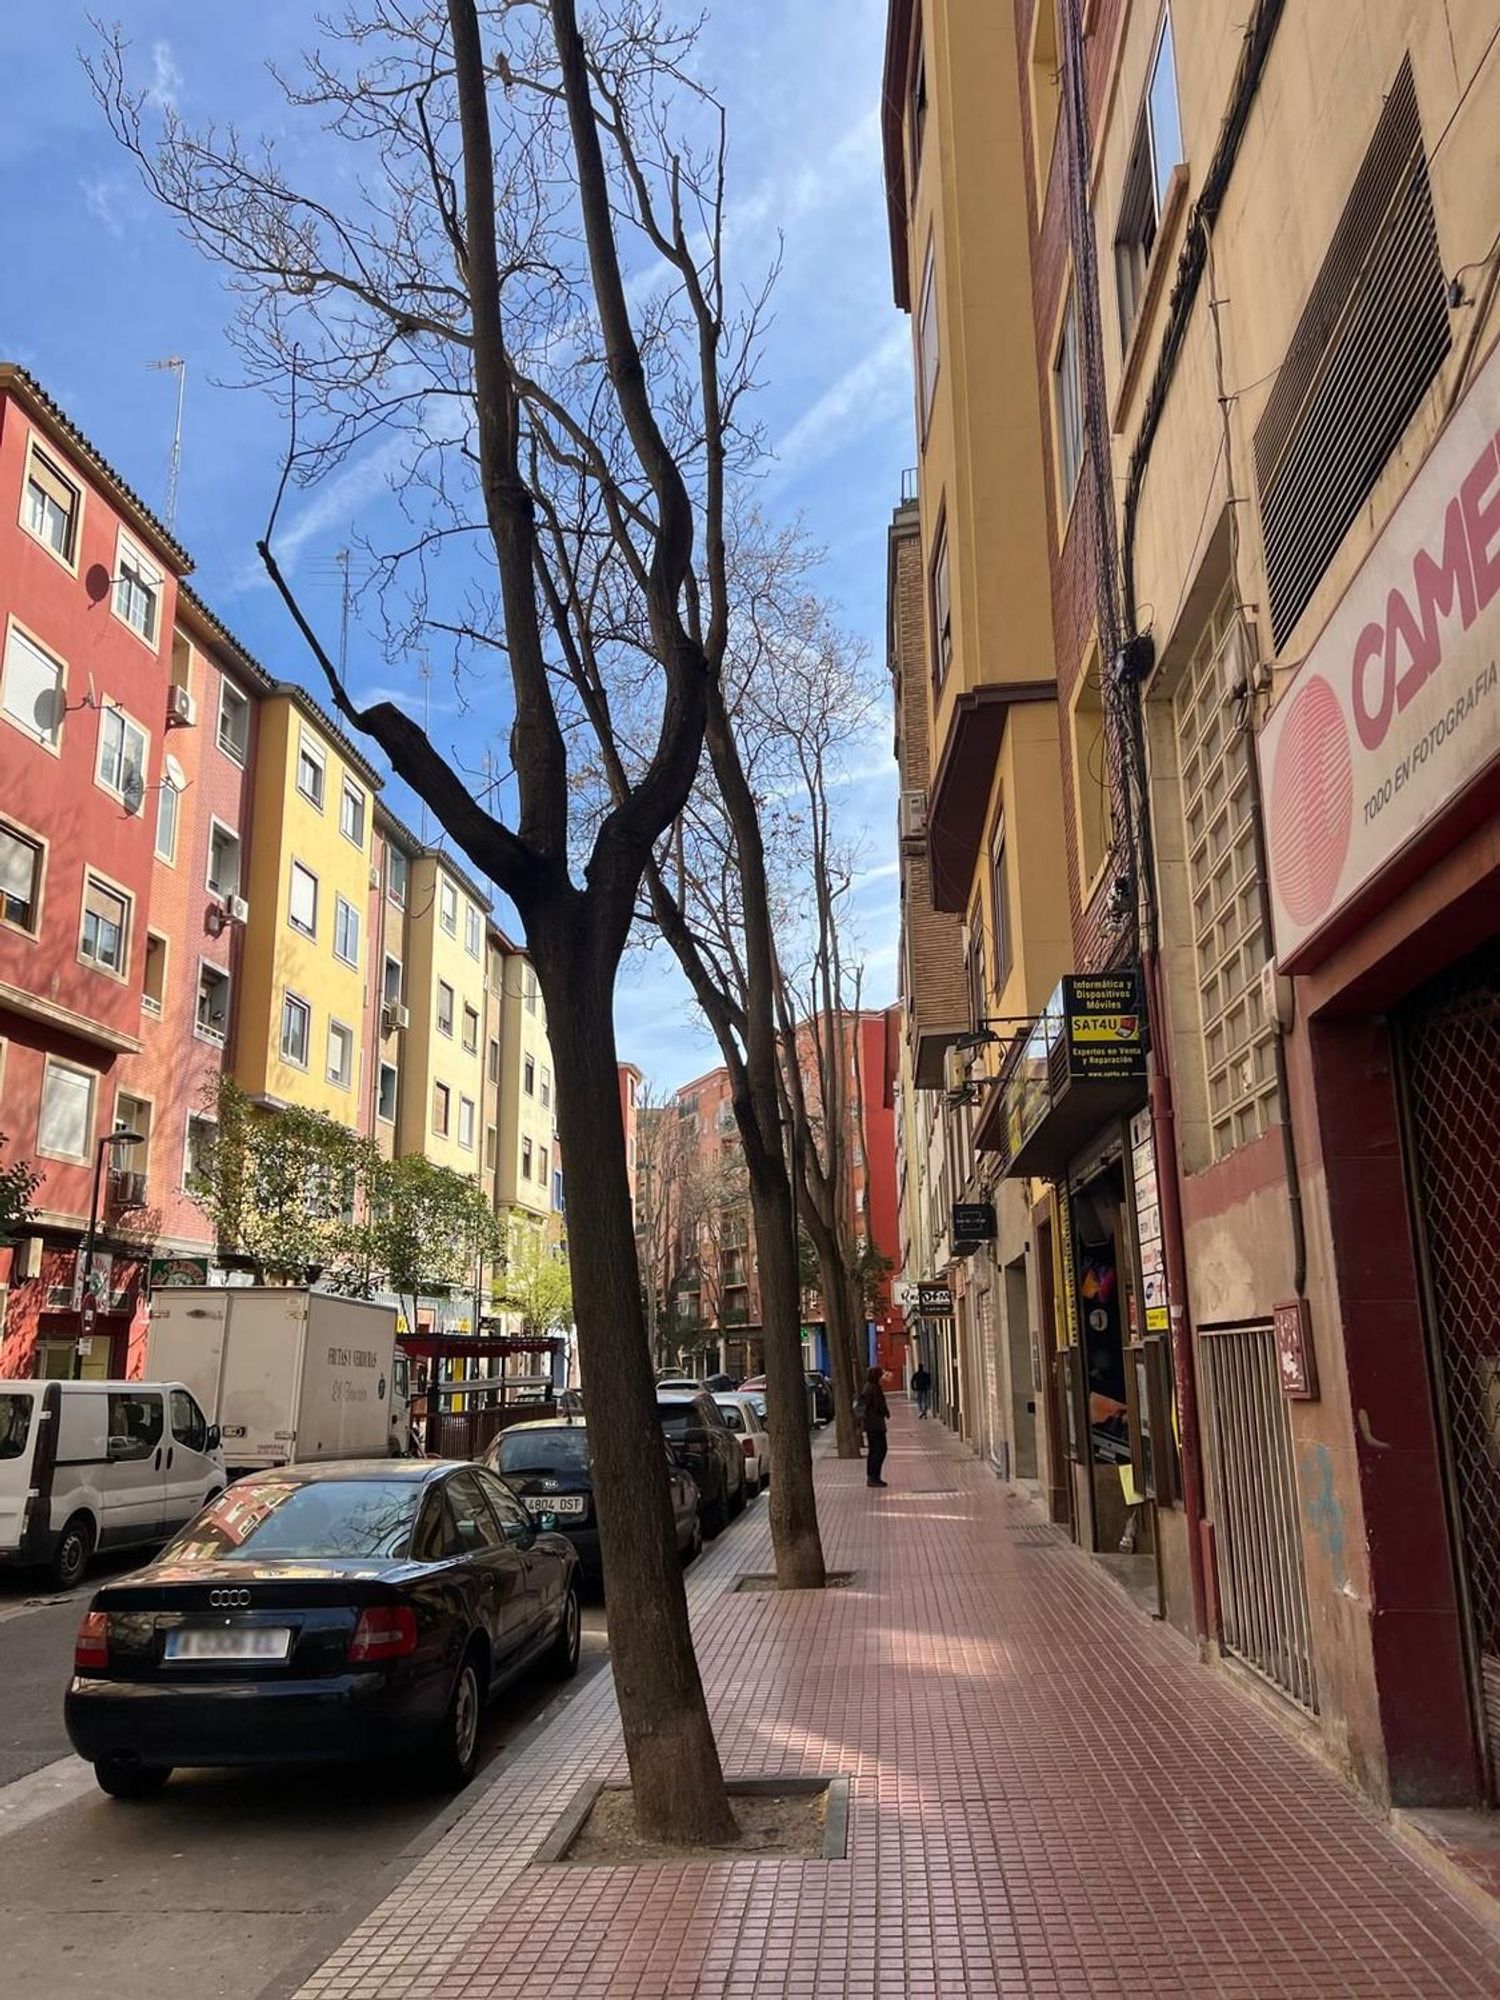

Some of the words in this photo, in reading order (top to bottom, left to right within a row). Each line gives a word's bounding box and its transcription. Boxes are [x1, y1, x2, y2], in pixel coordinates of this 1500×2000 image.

[1352, 425, 1500, 751] CAME
[1363, 778, 1393, 826] TODO
[1394, 756, 1411, 794] EN
[1412, 659, 1498, 772] FOTOGRAFIA
[1073, 980, 1125, 990] Informática
[1127, 981, 1132, 989] y
[1076, 990, 1131, 999] Dispositivos
[1086, 1001, 1121, 1010] Móviles
[1073, 1019, 1117, 1031] SAT4U
[1073, 1047, 1106, 1057] Expertos
[1119, 1046, 1141, 1055] Venta
[1082, 1057, 1088, 1066] y
[1089, 1056, 1133, 1066] Reparación
[528, 1498, 555, 1511] 4804
[559, 1498, 580, 1511] DST
